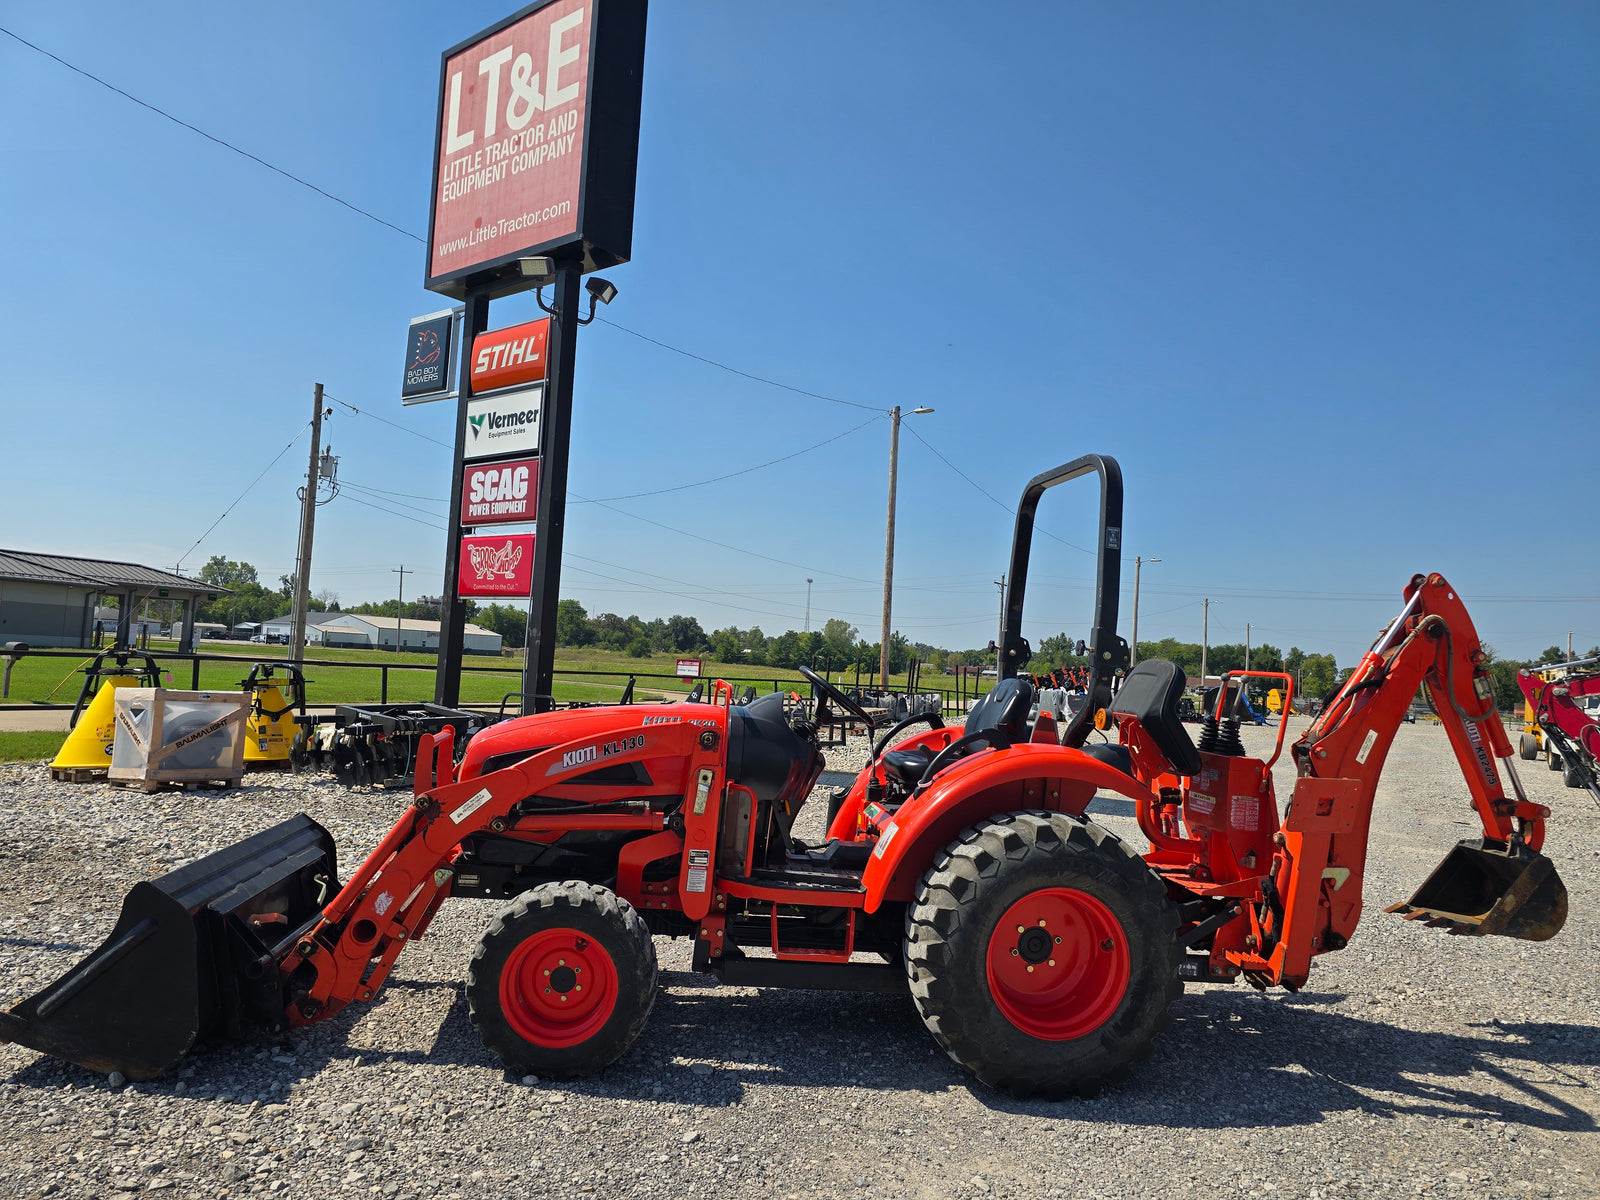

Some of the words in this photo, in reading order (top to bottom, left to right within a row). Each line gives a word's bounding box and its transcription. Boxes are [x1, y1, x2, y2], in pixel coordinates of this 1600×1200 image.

[446, 7, 584, 156] LT&E
[443, 150, 482, 183] LITTLE
[484, 123, 544, 165] TRACTOR
[547, 109, 578, 140] AND
[442, 160, 508, 203] EQUIPMENT
[511, 132, 576, 176] COMPANY
[439, 199, 571, 256] www.LittleTractor.com
[407, 368, 423, 378] BAD
[423, 365, 439, 375] BOY
[474, 336, 539, 374] STIHL
[407, 372, 439, 385] MOWERS
[487, 409, 540, 430] Vermeer
[488, 429, 513, 439] Equipment
[512, 427, 526, 435] Sales
[469, 466, 529, 503] SCAG
[468, 502, 490, 517] POWER
[490, 500, 527, 515] EQUIPMENT
[175, 719, 228, 749] BAUMALIGHT
[562, 745, 598, 768] KIOTI
[602, 734, 645, 757] KL130
[1475, 746, 1498, 785] KB2475
